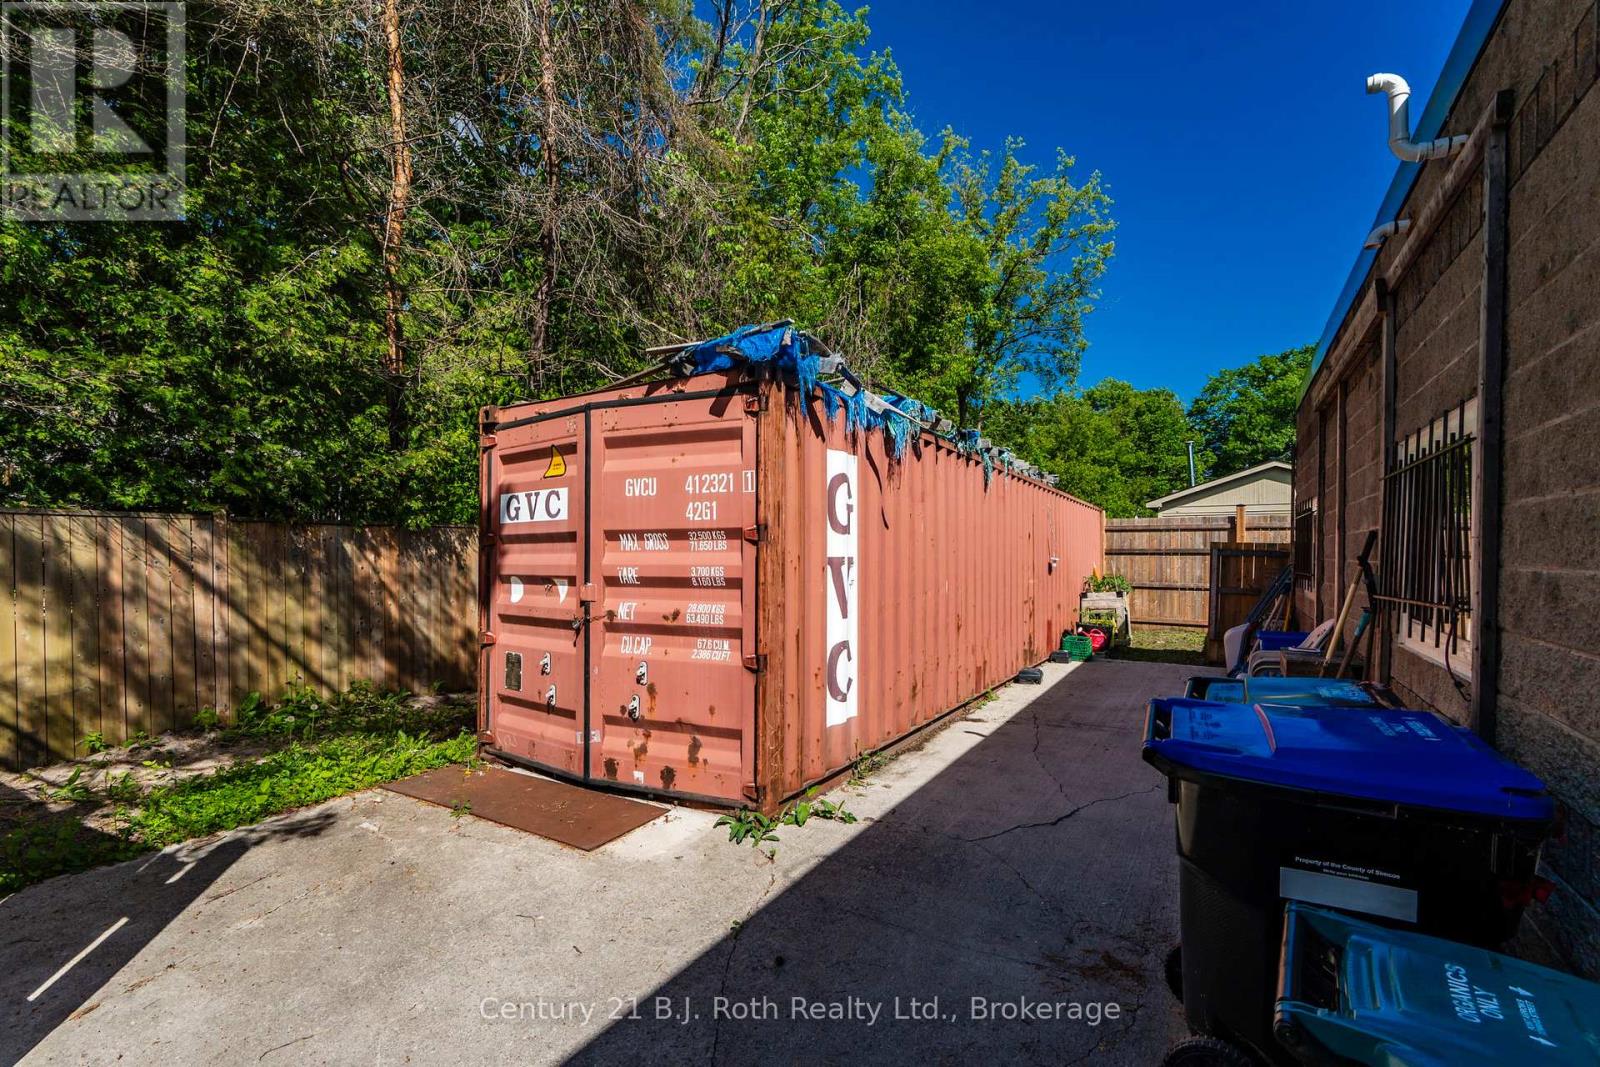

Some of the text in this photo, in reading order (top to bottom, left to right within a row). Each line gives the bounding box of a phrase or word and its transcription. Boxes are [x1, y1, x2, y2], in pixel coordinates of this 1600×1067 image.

[625, 477, 657, 497] GVCU
[685, 473, 734, 494] 412321
[506, 489, 562, 521] GVC
[685, 501, 718, 521] 42G1
[619, 533, 669, 551] MAX. GROSS
[712, 530, 727, 540] KGS
[714, 540, 727, 550] LBS
[617, 566, 641, 585] TARE
[711, 566, 724, 577] KGS
[711, 577, 726, 587] LBS
[618, 602, 637, 620] NET
[711, 604, 726, 614] KGS
[1444, 963, 1480, 1023] ORGANICS
[1472, 985, 1504, 1020] ONLY
